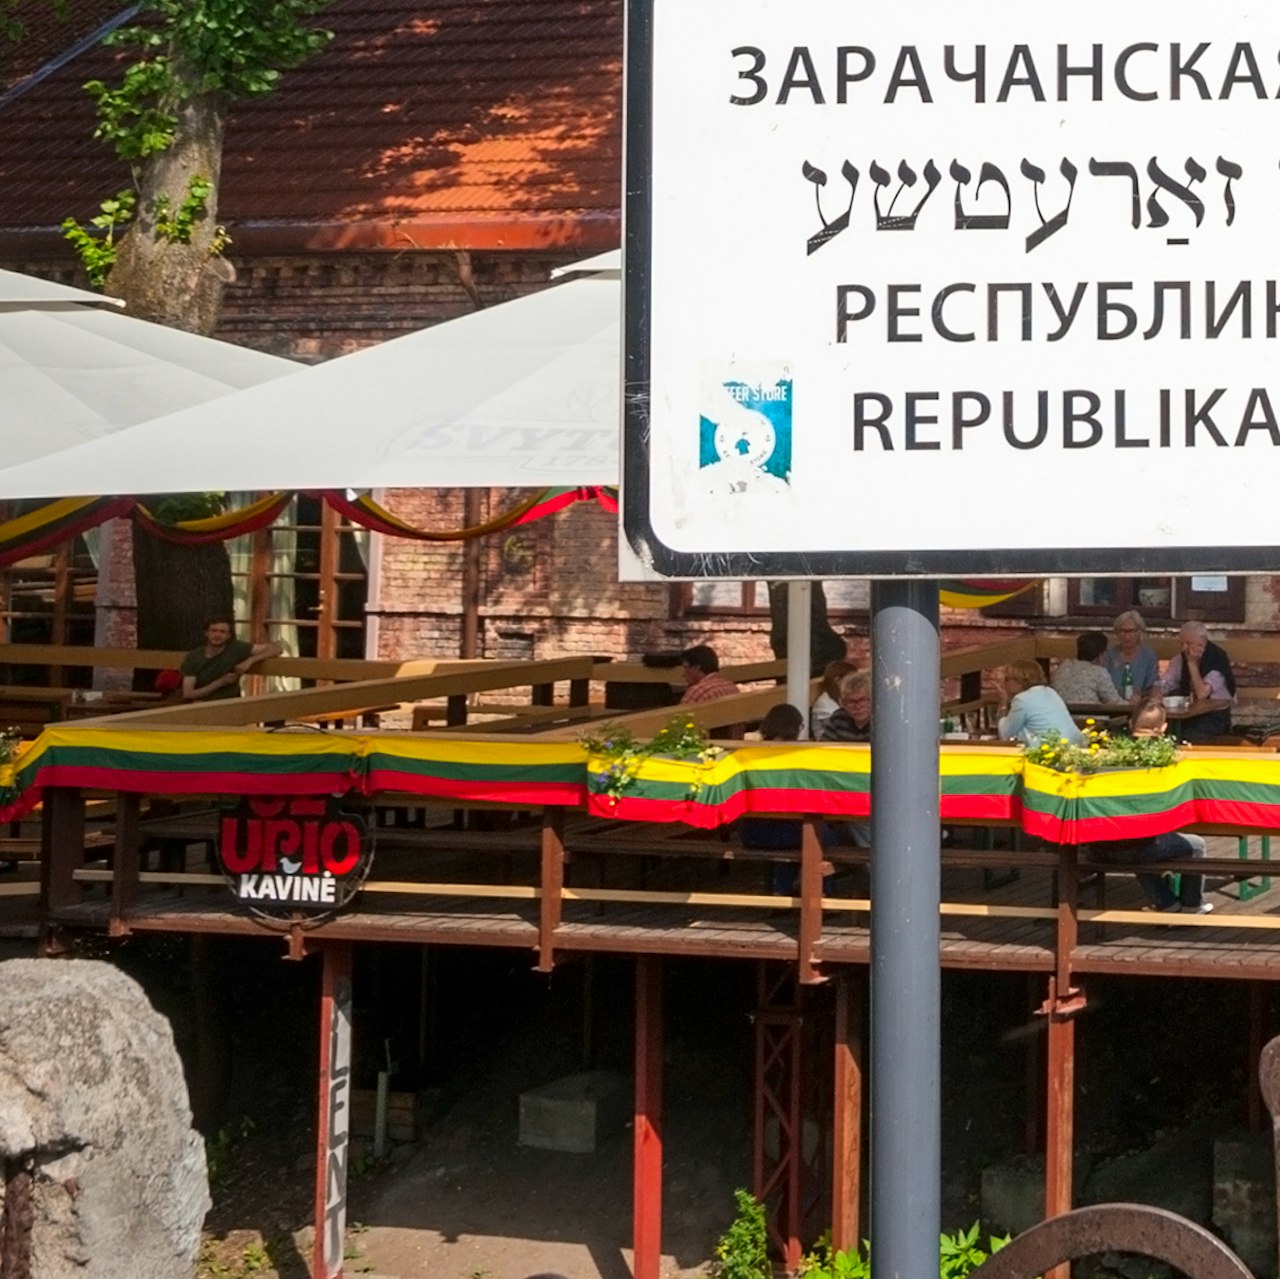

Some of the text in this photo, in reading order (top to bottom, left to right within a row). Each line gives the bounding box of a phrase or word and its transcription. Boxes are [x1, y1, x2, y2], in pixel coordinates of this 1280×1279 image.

[407, 424, 618, 451] SVYT
[220, 817, 361, 875] UPIO
[239, 870, 336, 903] KAVINĖ
